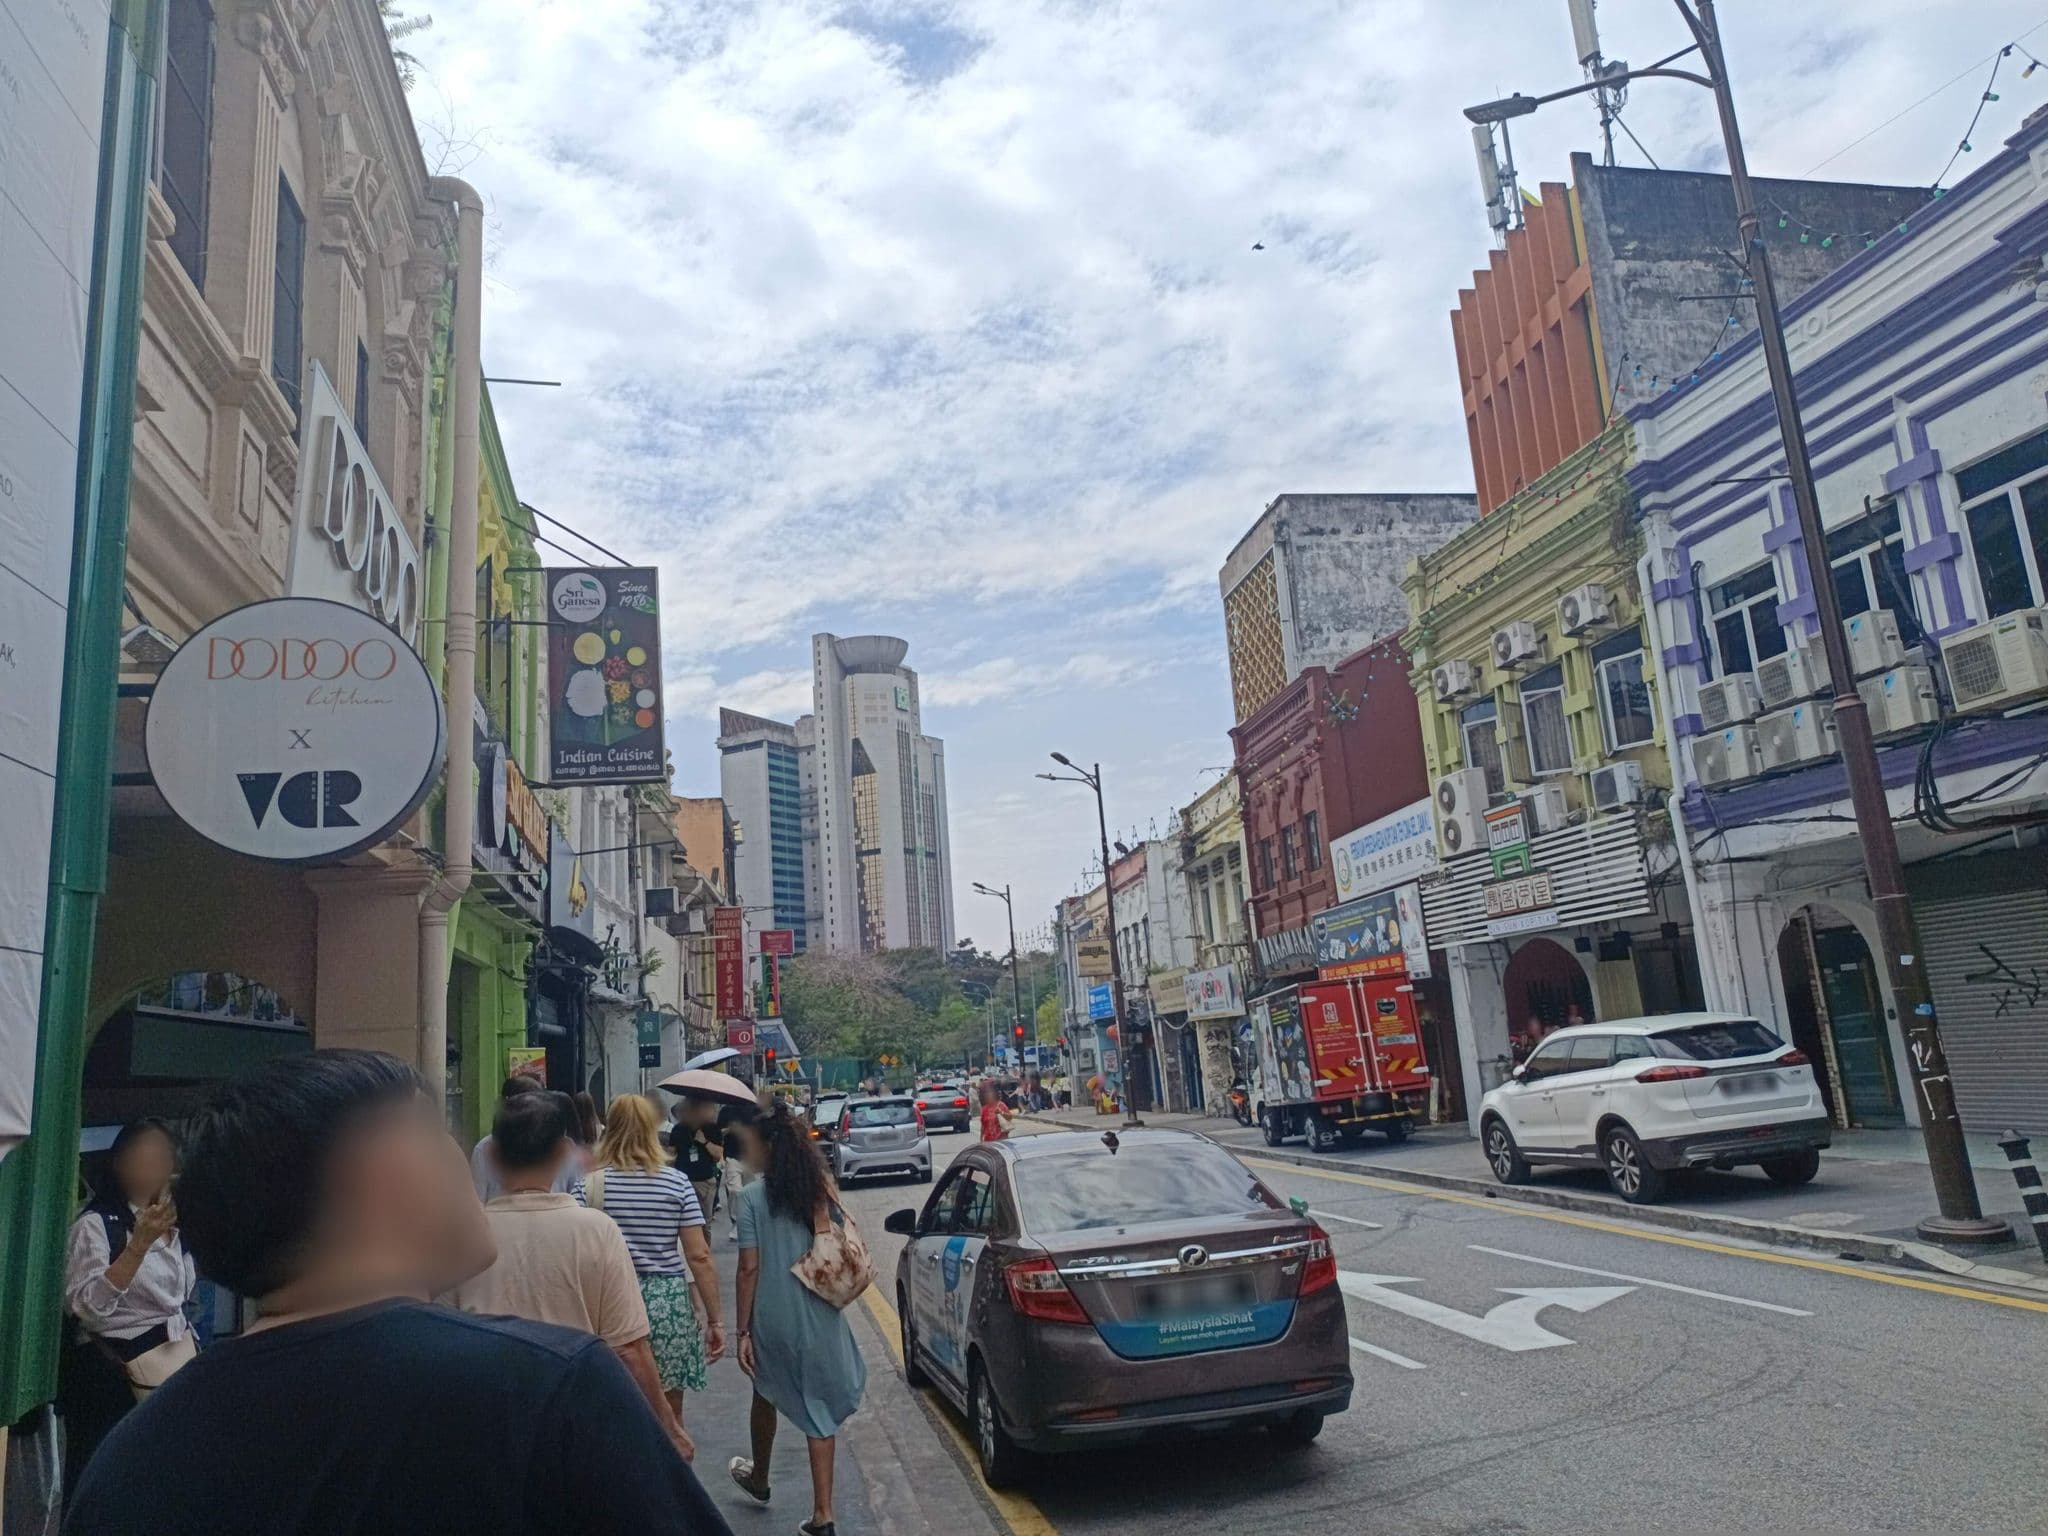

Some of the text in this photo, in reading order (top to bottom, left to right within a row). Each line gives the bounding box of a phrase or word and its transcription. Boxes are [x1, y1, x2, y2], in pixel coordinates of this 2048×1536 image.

[565, 587, 584, 598] Sri
[617, 580, 648, 593] Since
[558, 594, 601, 610] Ganesa
[207, 637, 397, 681] DODOO
[305, 685, 393, 713] kitchen
[559, 748, 655, 765] Indian Cuisine
[236, 770, 362, 831] VCR
[1257, 923, 1316, 967] MAKAMAKA
[1159, 1310, 1255, 1335] #MalaysiaSihat
